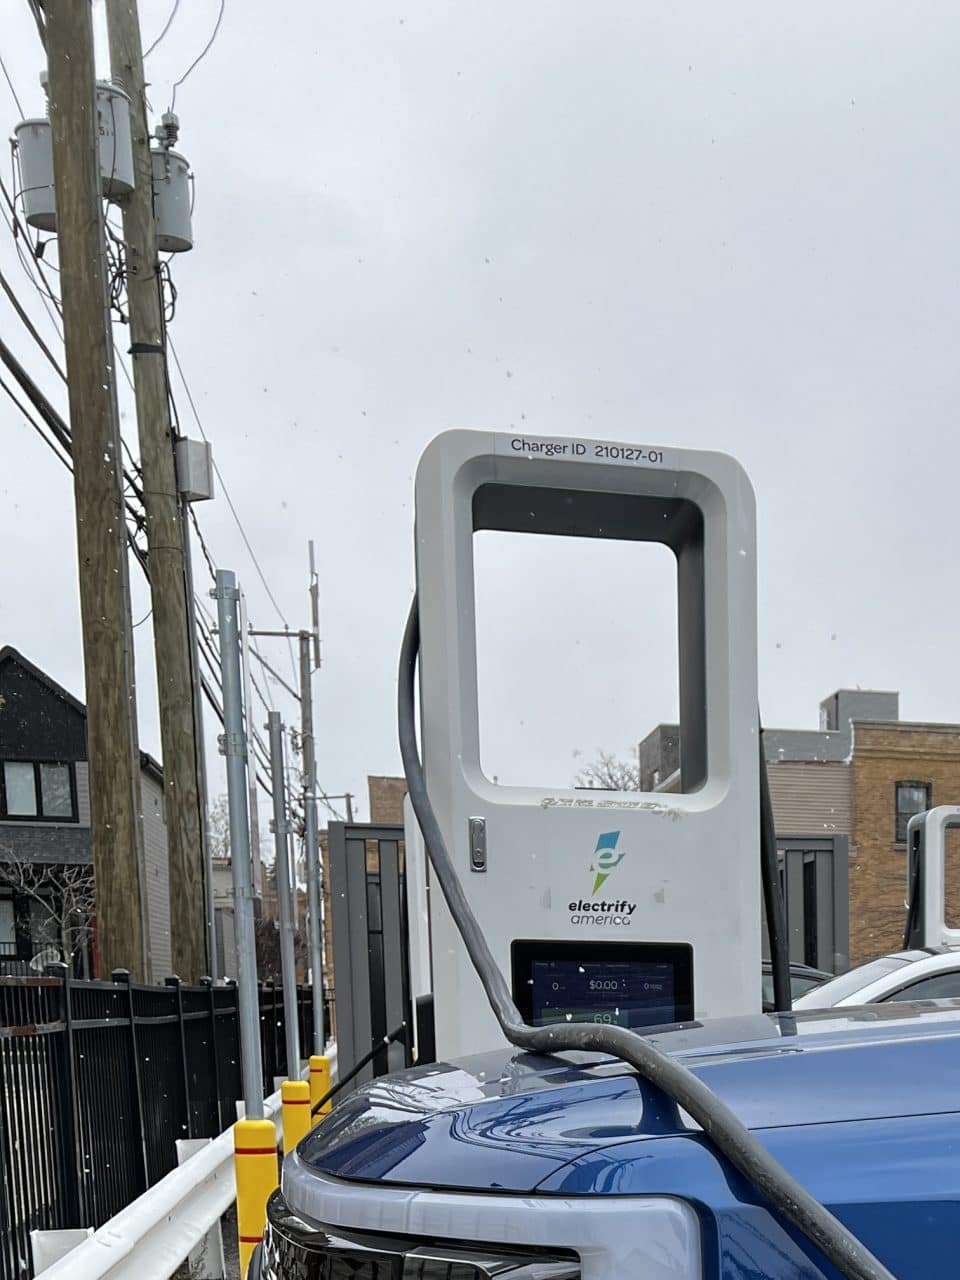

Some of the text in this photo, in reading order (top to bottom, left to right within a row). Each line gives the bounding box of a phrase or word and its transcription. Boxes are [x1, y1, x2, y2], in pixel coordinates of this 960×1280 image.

[511, 438, 663, 463] Charger ID 210127-01
[568, 899, 637, 915] electrify
[570, 914, 631, 926] america
[589, 980, 618, 990] $0.00
